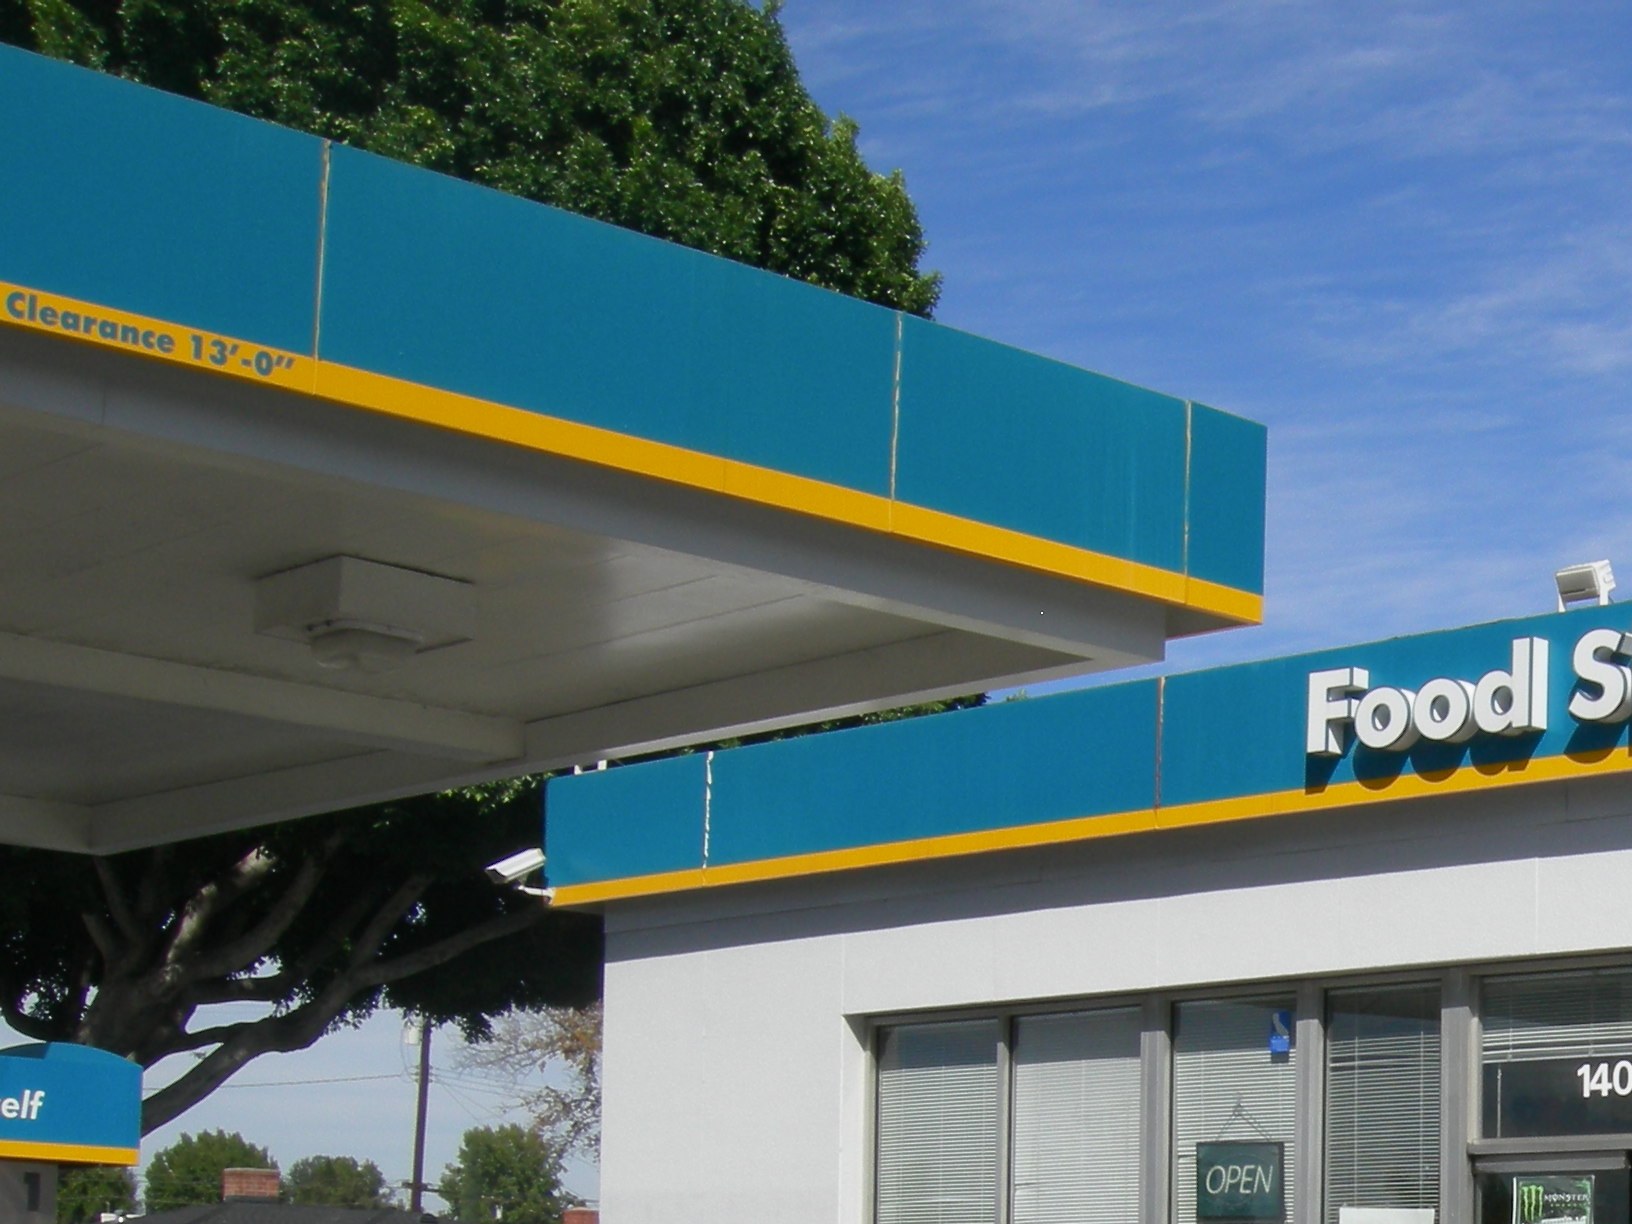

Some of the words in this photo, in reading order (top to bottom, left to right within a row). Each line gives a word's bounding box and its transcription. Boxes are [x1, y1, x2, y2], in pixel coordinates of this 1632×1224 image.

[5, 291, 176, 353] Clearance
[1306, 635, 1548, 756] Food
[1, 1089, 46, 1120] elf
[1206, 1165, 1273, 1194] OPEN
